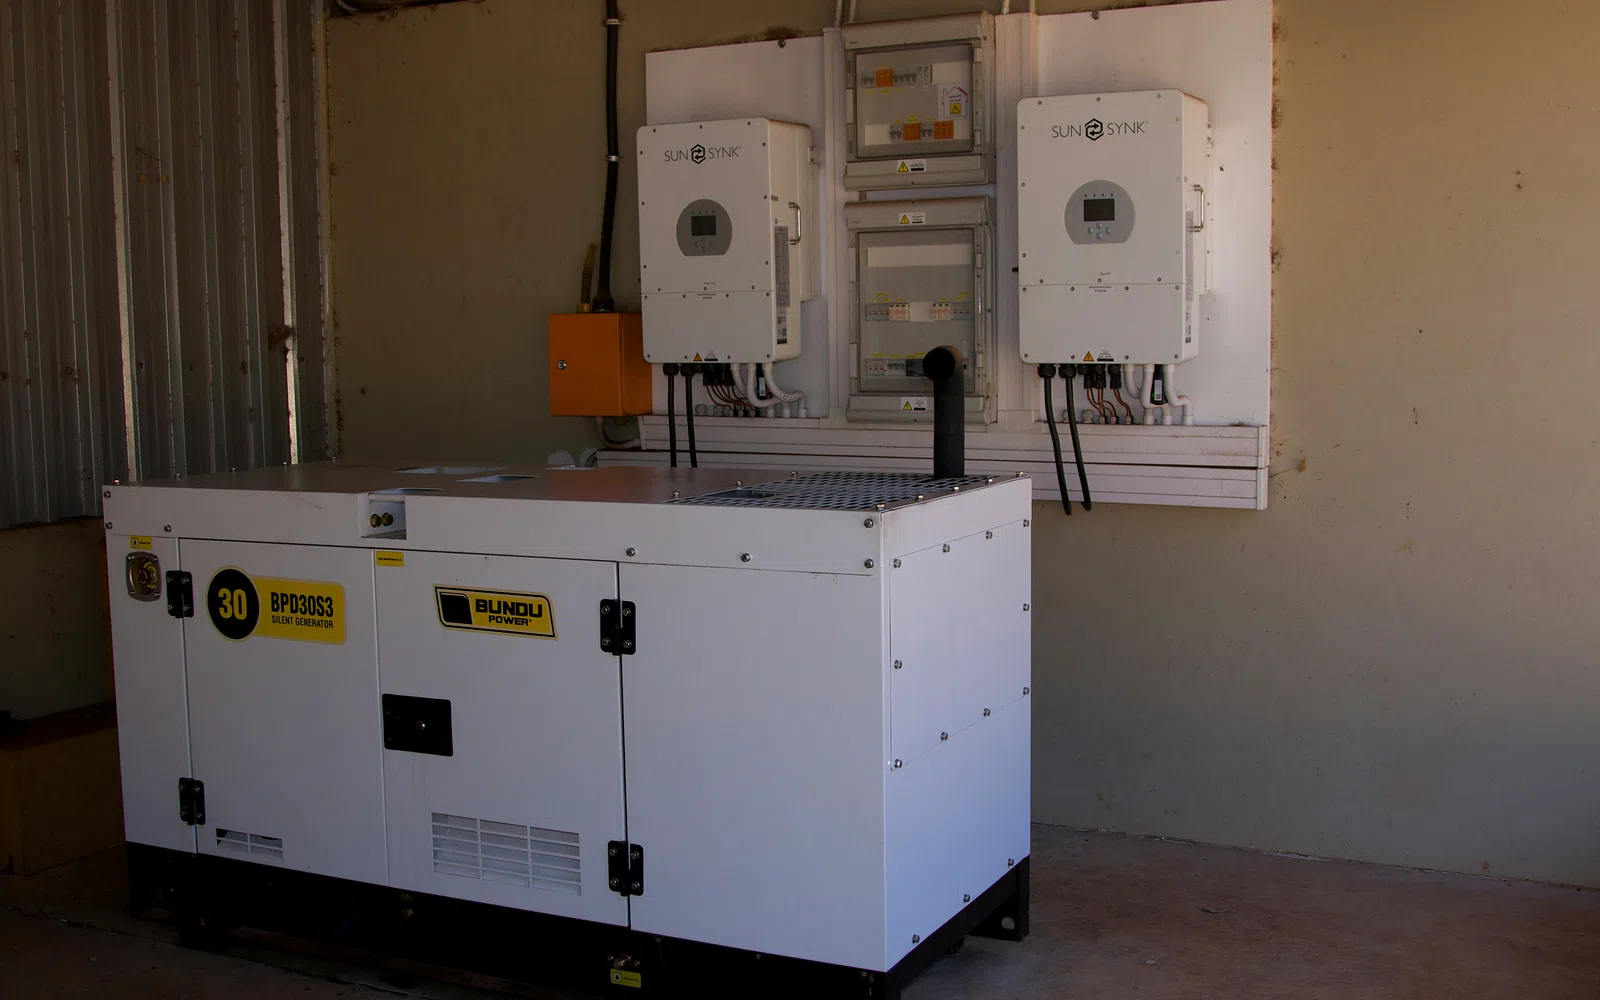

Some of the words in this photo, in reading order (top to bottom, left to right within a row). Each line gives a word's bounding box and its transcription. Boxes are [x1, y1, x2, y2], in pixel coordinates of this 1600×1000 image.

[1051, 125, 1082, 139] SUN
[664, 149, 689, 162] SUN
[218, 587, 248, 620] 30
[270, 592, 334, 617] BPD30S3
[475, 598, 543, 618] BUNDU
[271, 614, 294, 625] SILENT
[295, 617, 334, 629] GENERATOR
